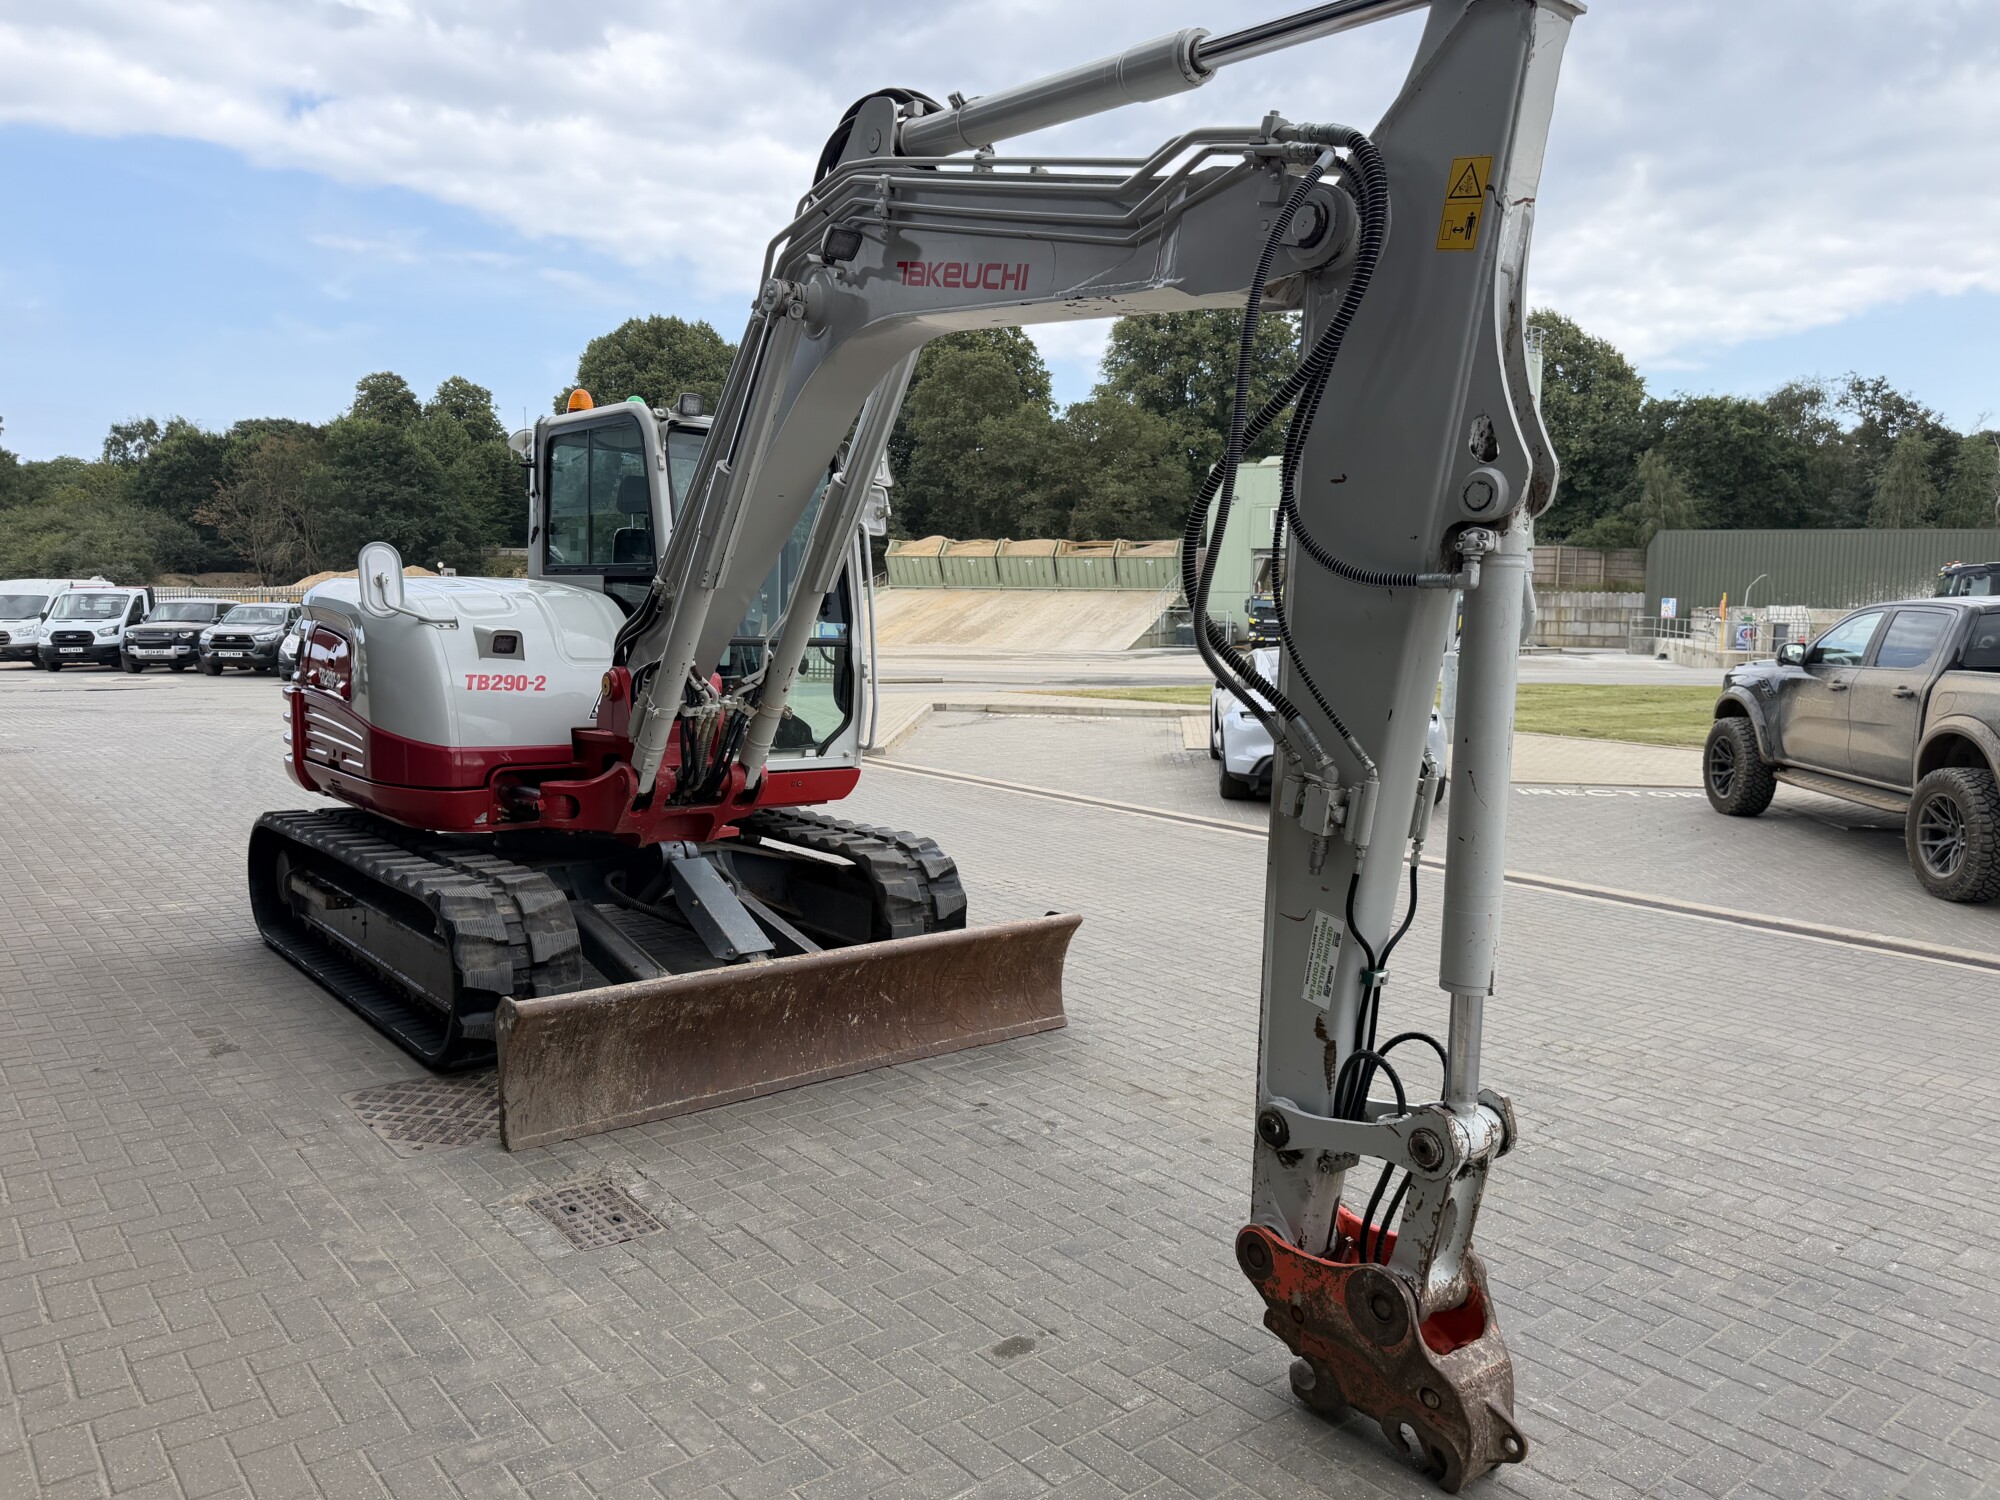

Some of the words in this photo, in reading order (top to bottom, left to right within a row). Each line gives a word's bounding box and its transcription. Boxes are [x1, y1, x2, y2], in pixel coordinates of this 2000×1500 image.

[465, 674, 547, 692] TB290-2
[1515, 788, 1707, 799] IRECTOR
[1315, 916, 1328, 960] TWINLOCK
[1321, 925, 1333, 964] GENUINE
[1308, 960, 1320, 1001] COUPLER
[1316, 964, 1327, 997] MILLER
